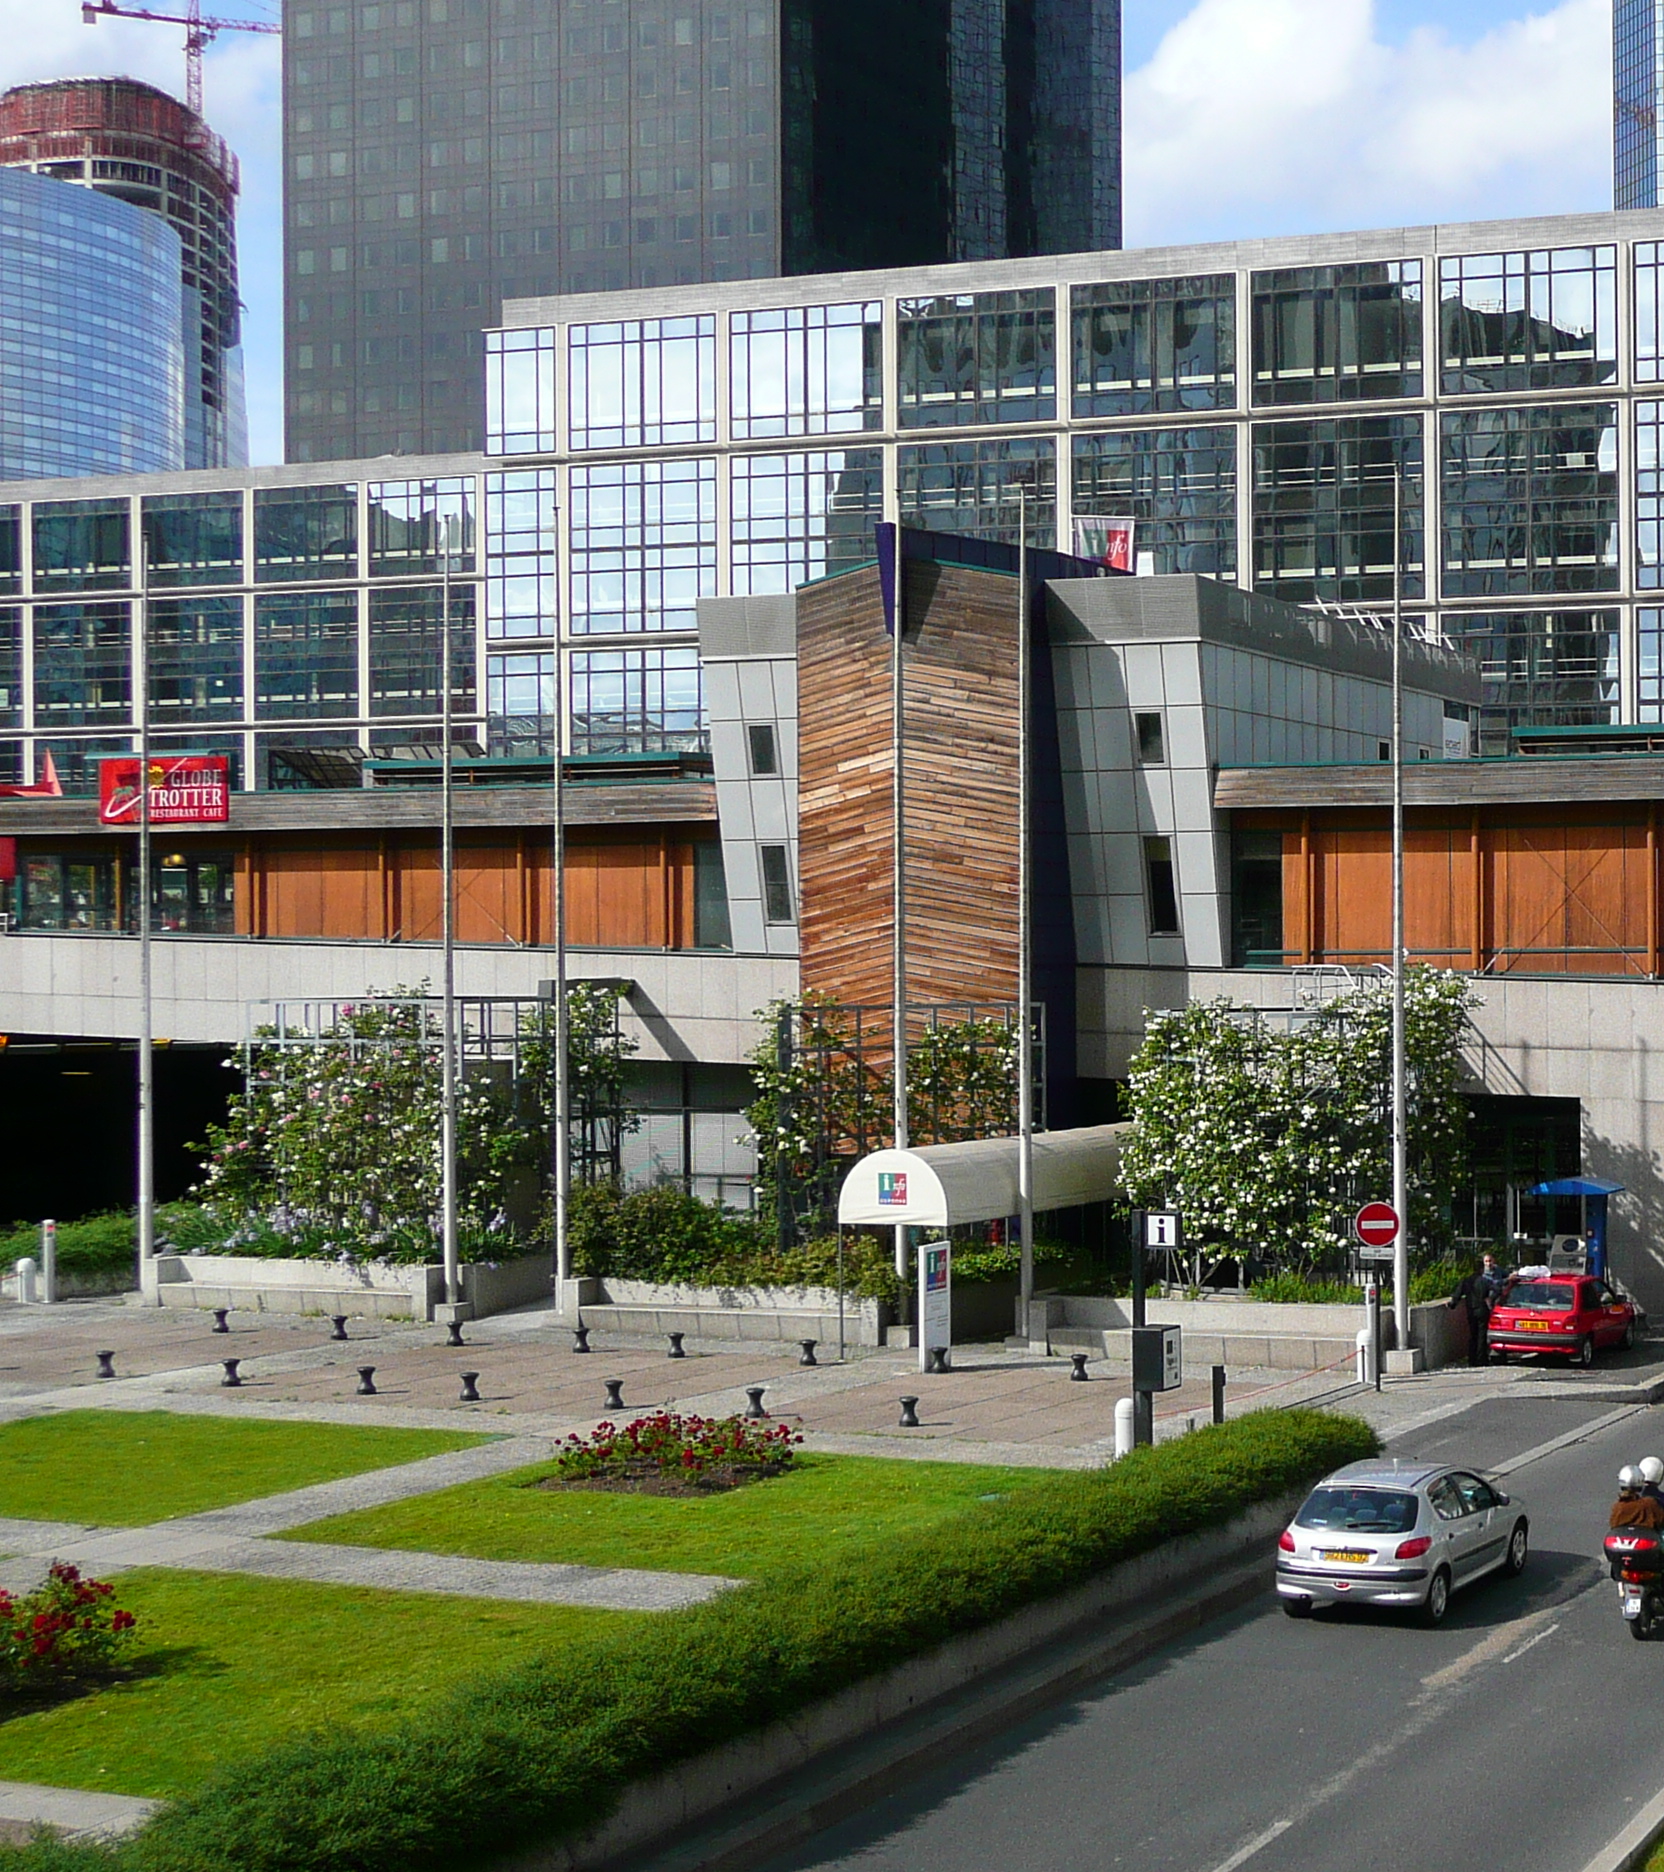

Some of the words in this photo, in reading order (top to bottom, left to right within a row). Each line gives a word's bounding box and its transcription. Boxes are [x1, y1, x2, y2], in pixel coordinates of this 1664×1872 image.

[171, 769, 222, 788] GLOBE
[149, 788, 223, 807] TROTTER
[150, 808, 199, 818] RESTAURANT
